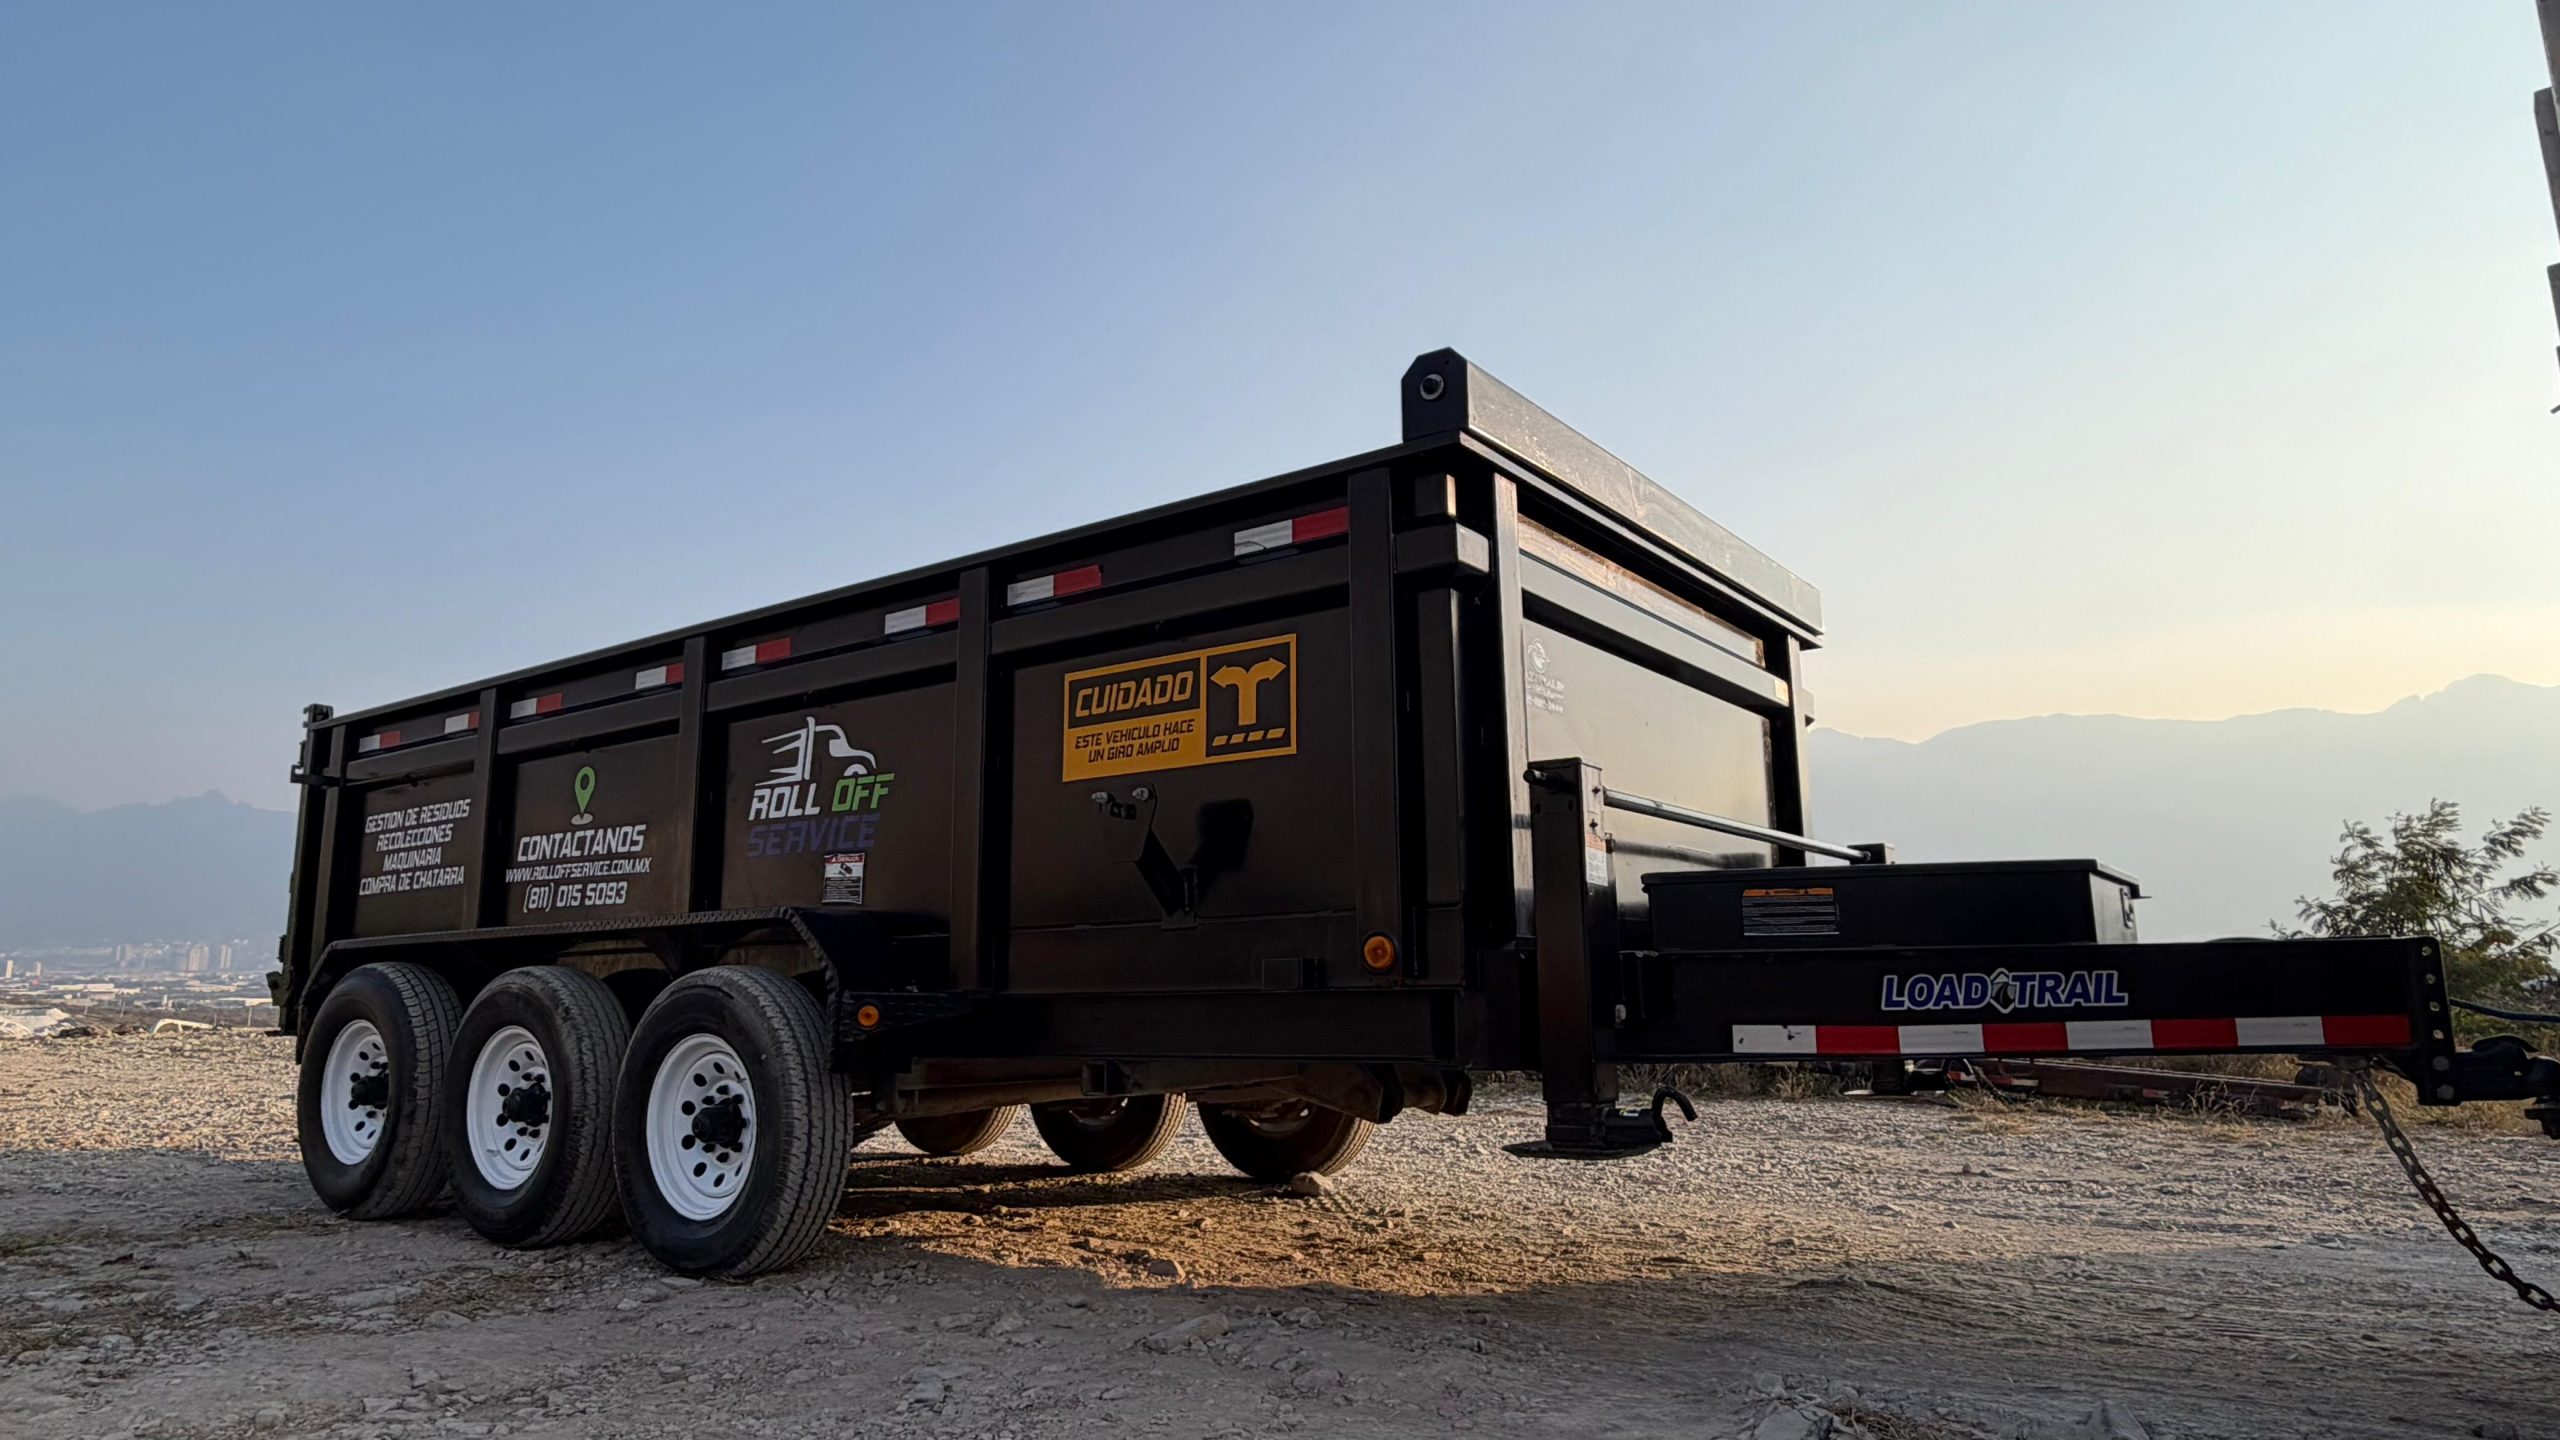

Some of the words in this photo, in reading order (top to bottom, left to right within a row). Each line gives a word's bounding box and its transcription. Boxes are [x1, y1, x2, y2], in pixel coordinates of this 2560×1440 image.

[1075, 670, 1194, 718] CUIDADO
[1075, 732, 1103, 749] ESTE
[1105, 724, 1161, 744] VEHICULO
[1163, 718, 1196, 737] HACE
[1088, 748, 1105, 763] UN
[1107, 744, 1134, 761] GIRO
[1136, 737, 1180, 757] AMPLIO
[748, 782, 821, 821] ROLL
[831, 773, 896, 812] OFF
[365, 809, 404, 833] GESTION
[405, 807, 420, 826] DE
[420, 798, 472, 824] RESIDUOS
[376, 823, 454, 852] RECOLECCIONES
[517, 824, 647, 862] CONTACTANOS
[747, 813, 881, 857] SERVICE
[382, 846, 442, 872] MAQUINARIA
[358, 874, 396, 896] COMPRA
[397, 872, 413, 892] DE
[412, 865, 465, 889] CHATARRA
[523, 882, 554, 913] (811)
[556, 883, 582, 908] 015
[584, 881, 628, 906] 5093
[1881, 973, 1992, 1011] LOAD
[2009, 970, 2129, 1009] TRAIL
